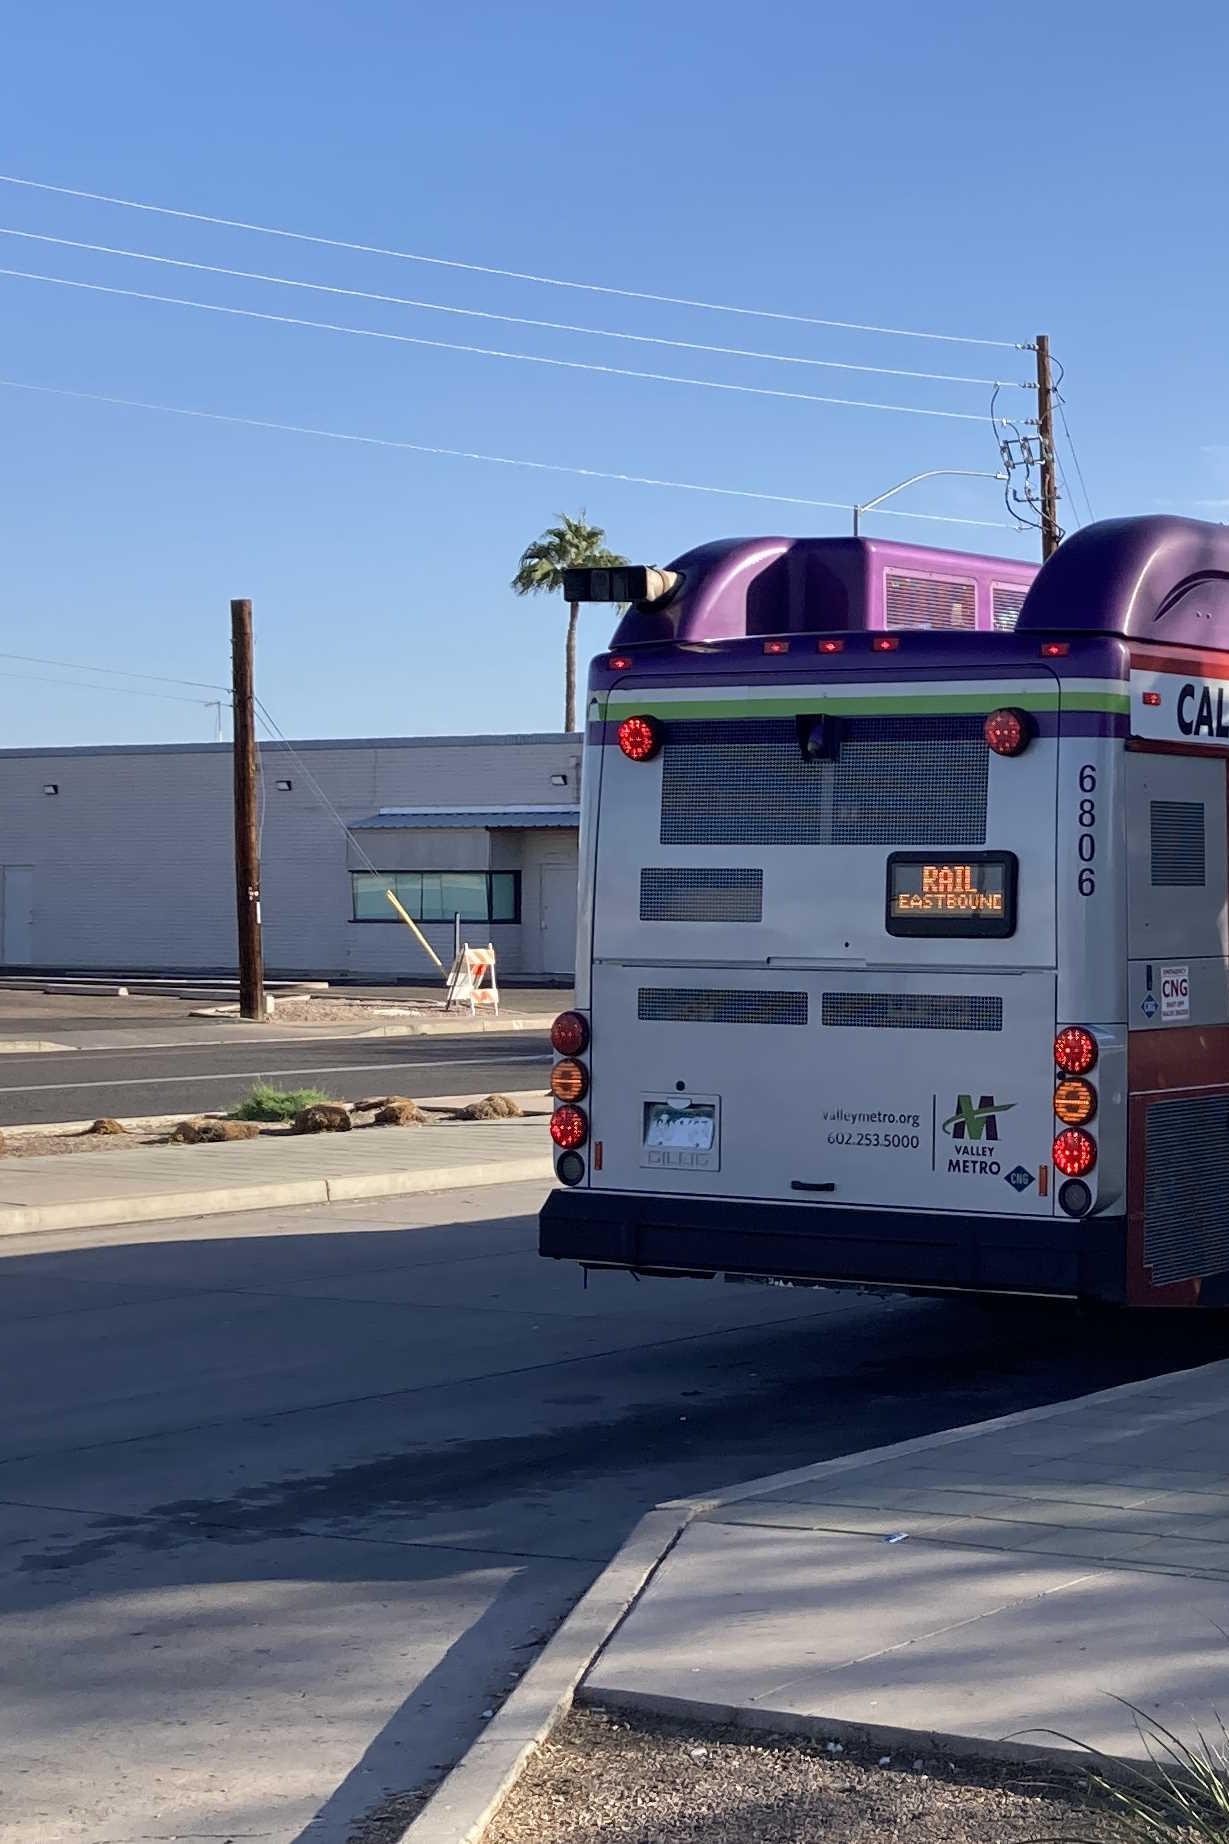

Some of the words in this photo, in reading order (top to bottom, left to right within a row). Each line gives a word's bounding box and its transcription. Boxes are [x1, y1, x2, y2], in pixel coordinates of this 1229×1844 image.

[1078, 764, 1097, 897] 6806
[922, 865, 977, 892] RAIL
[1162, 978, 1188, 998] CNG
[823, 1108, 920, 1128] valleymetro.org
[827, 1131, 920, 1149] 602.253.5000
[954, 1144, 994, 1157] VALLEY
[947, 1159, 1001, 1176] METRO
[1010, 1172, 1029, 1186] CNG
